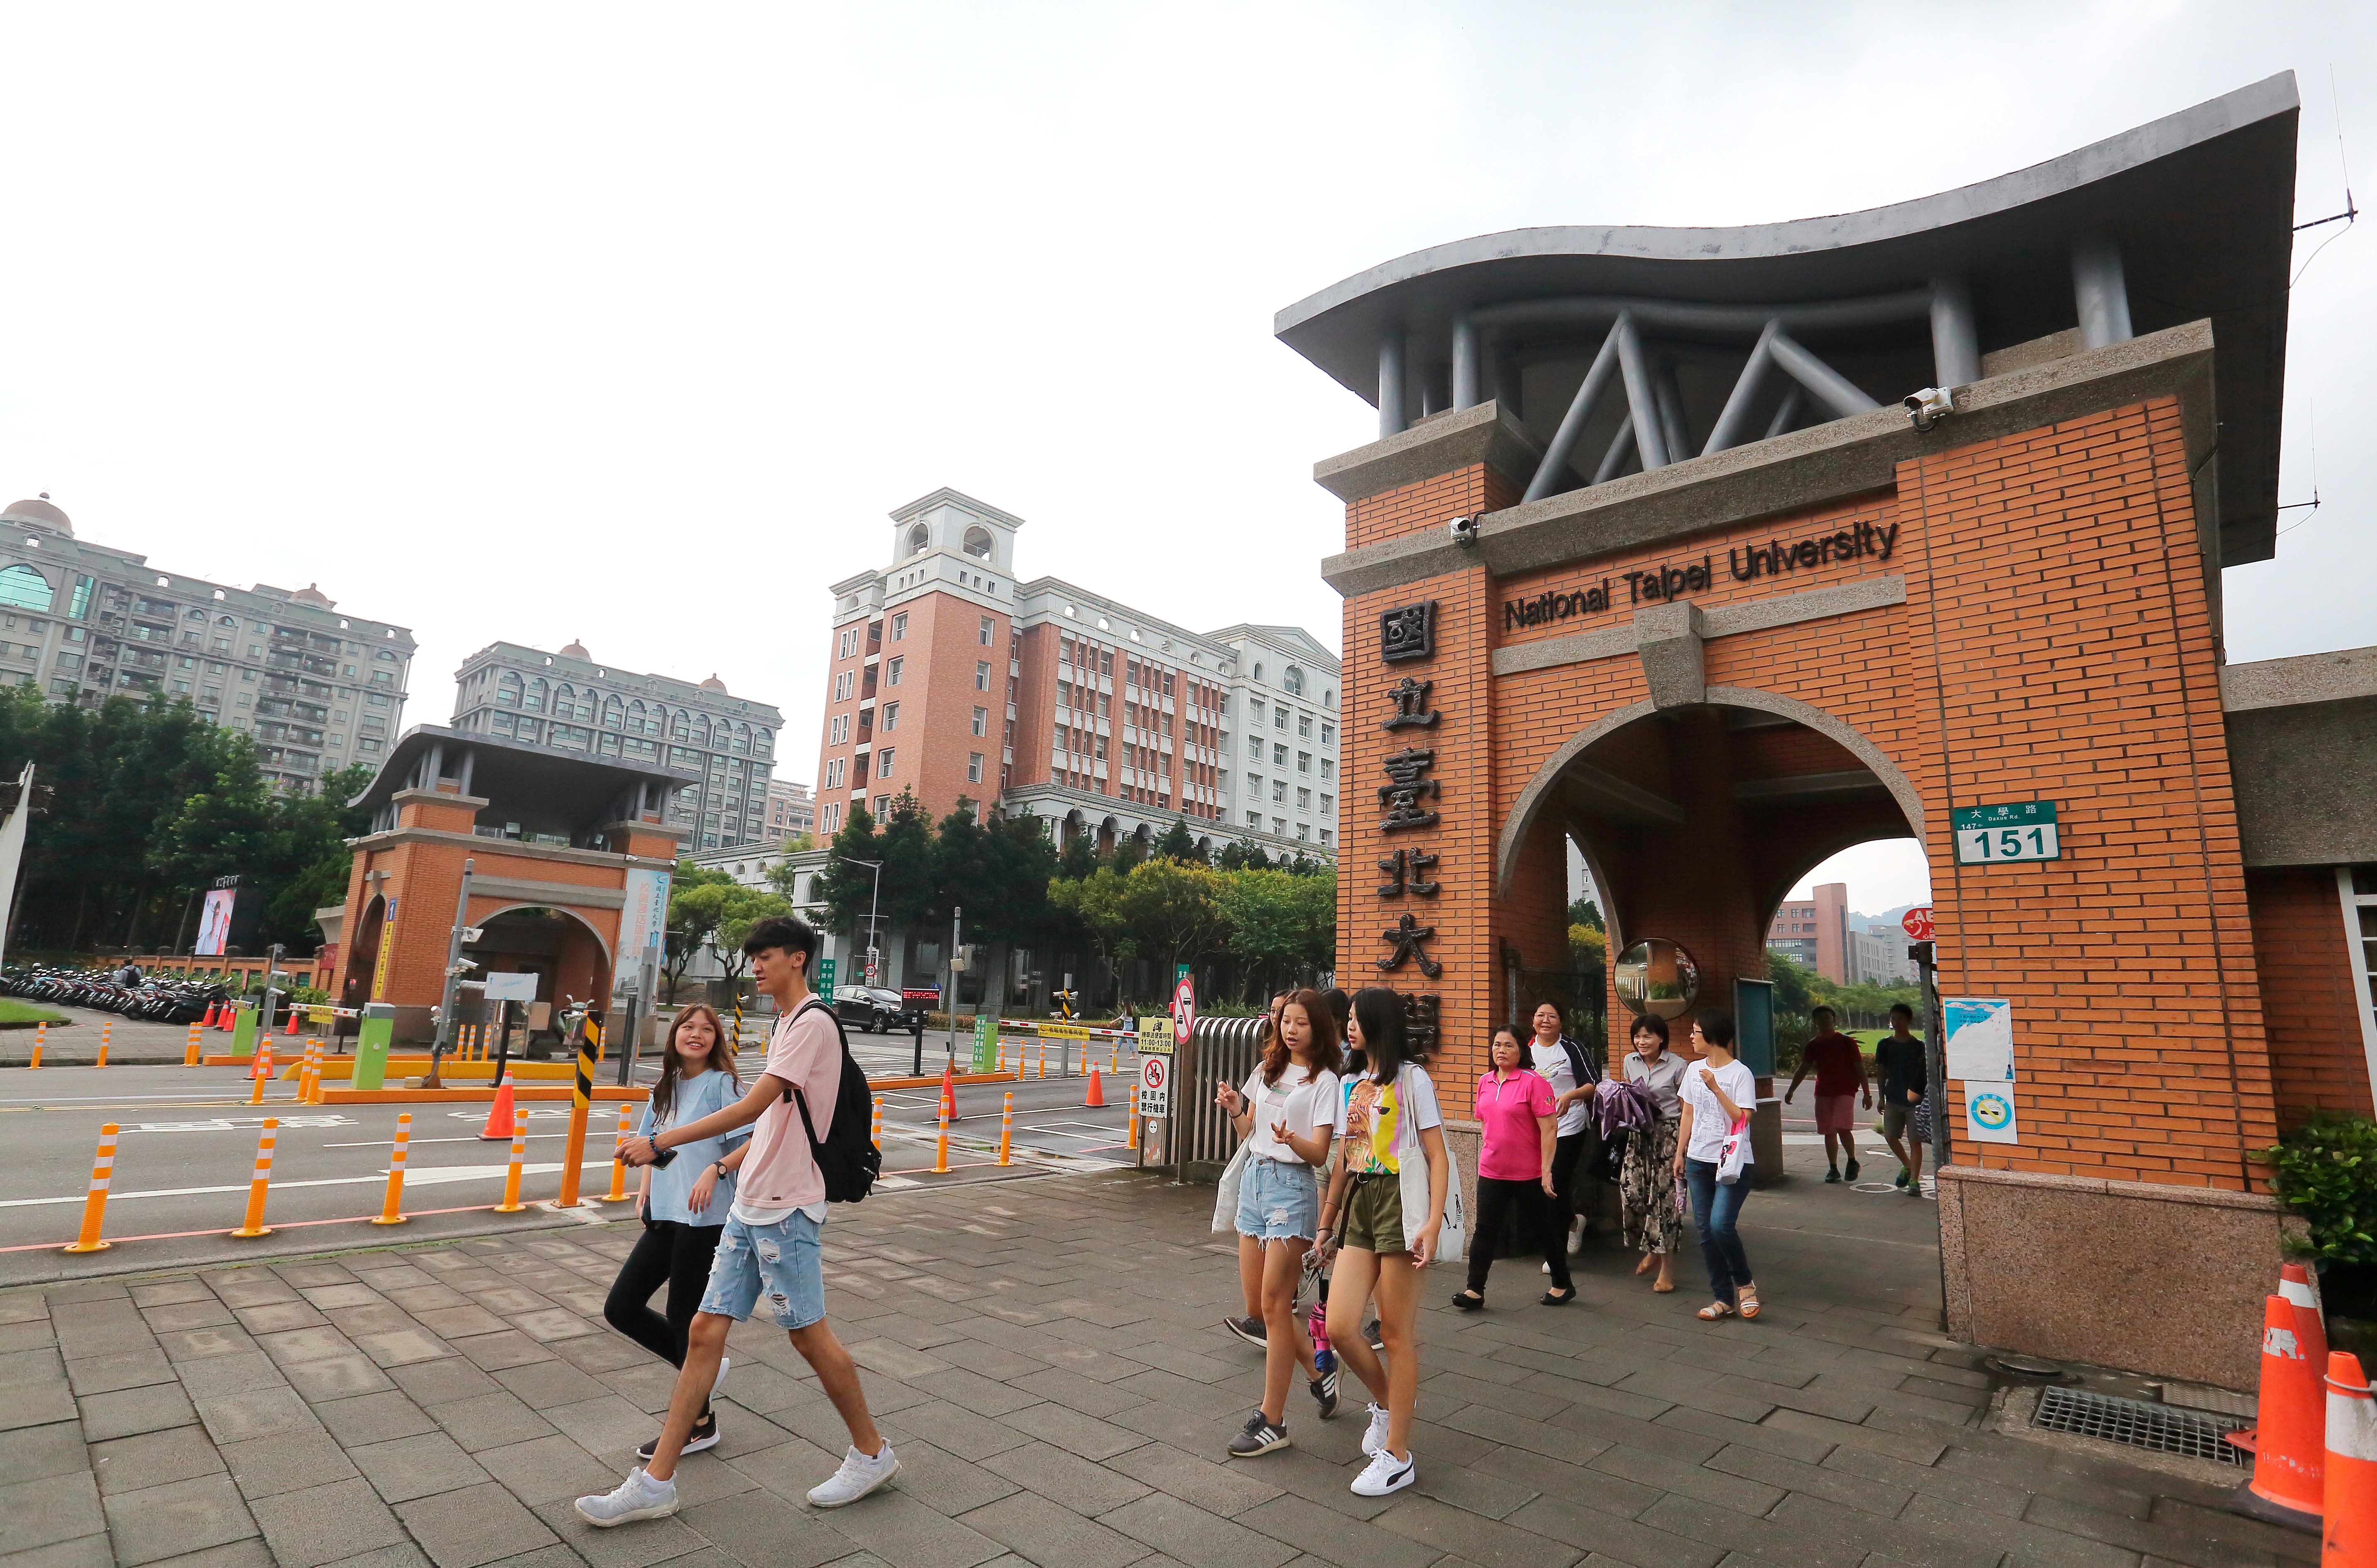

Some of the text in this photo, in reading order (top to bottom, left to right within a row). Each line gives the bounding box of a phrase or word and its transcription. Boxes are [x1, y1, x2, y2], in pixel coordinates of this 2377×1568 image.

[1505, 519, 1898, 630] National Taipei University
[1971, 805, 2037, 818] 大學路
[1975, 828, 2044, 858] 151
[390, 903, 395, 920] 1
[1141, 1039, 1171, 1047] 11:00-13:00
[1141, 1090, 1165, 1102] 校園內
[1141, 1102, 1165, 1114] 禁行機車
